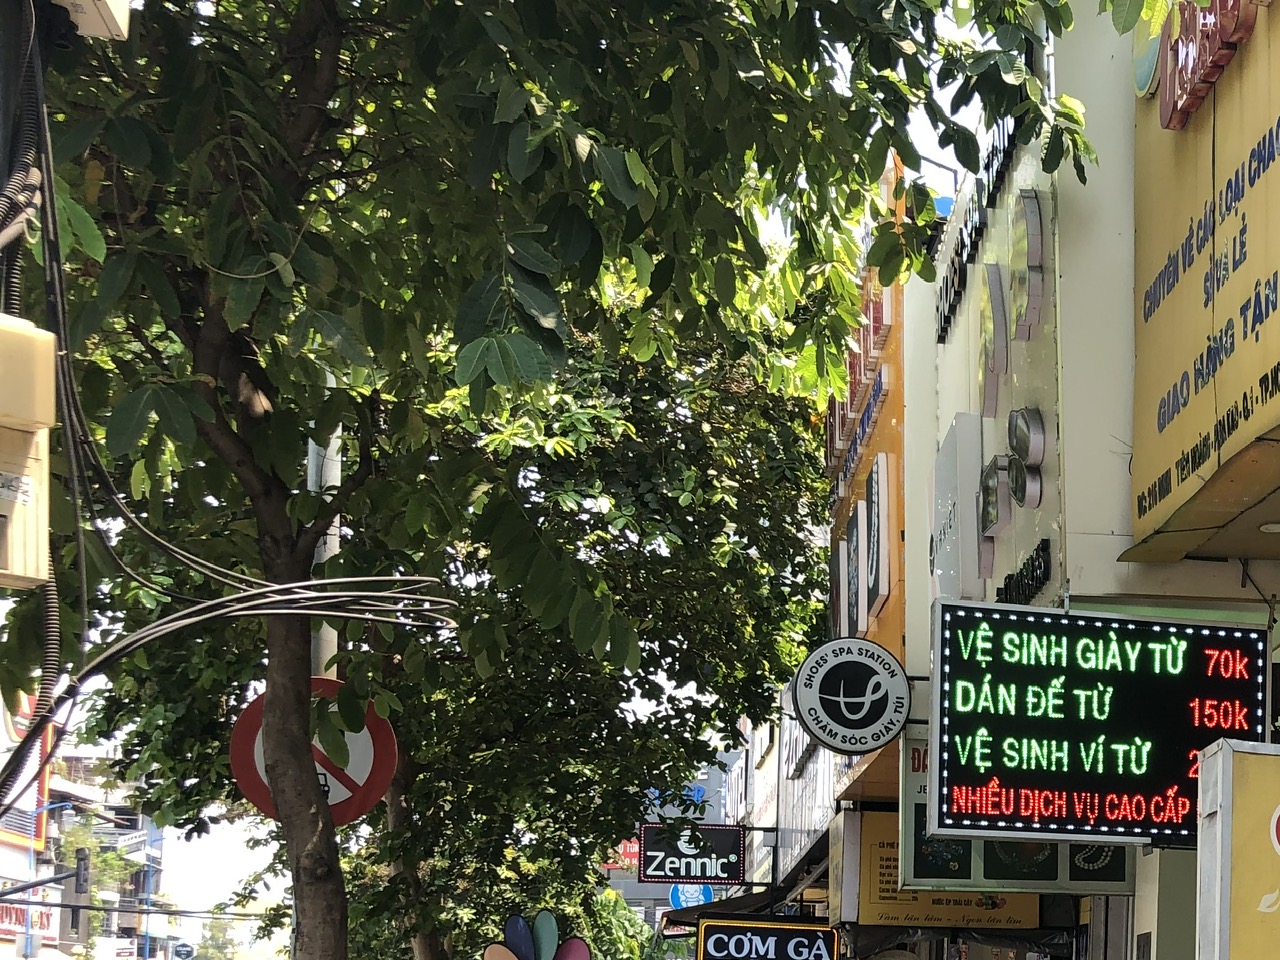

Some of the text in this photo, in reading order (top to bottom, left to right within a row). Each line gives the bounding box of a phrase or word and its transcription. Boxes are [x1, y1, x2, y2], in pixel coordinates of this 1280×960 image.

[1143, 251, 1179, 324] CHUYÊN
[1219, 161, 1245, 225] LOẠI
[1158, 371, 1190, 433] GIAO
[1194, 318, 1235, 395] HÀNG
[1240, 270, 1278, 343] TẬN
[832, 647, 854, 658] SPA
[857, 648, 898, 678] STATION
[957, 622, 1248, 679] VỆ SINH GIÀY TỪ 70k
[808, 707, 838, 740] CHĂM
[841, 734, 868, 745] SÓC
[892, 697, 904, 715] TÚI
[955, 674, 1248, 730] DÁN ĐẾ TỪ 150k
[955, 726, 992, 773] VỆ
[1002, 737, 1068, 772] SINH
[1079, 735, 1106, 773] VÍ
[1111, 737, 1152, 775] TỪ
[952, 776, 1190, 824] NHIỀU DỊCH VỤ CAO CẤP
[646, 852, 728, 877] Zennic
[707, 933, 830, 960] CƠM GÀ
